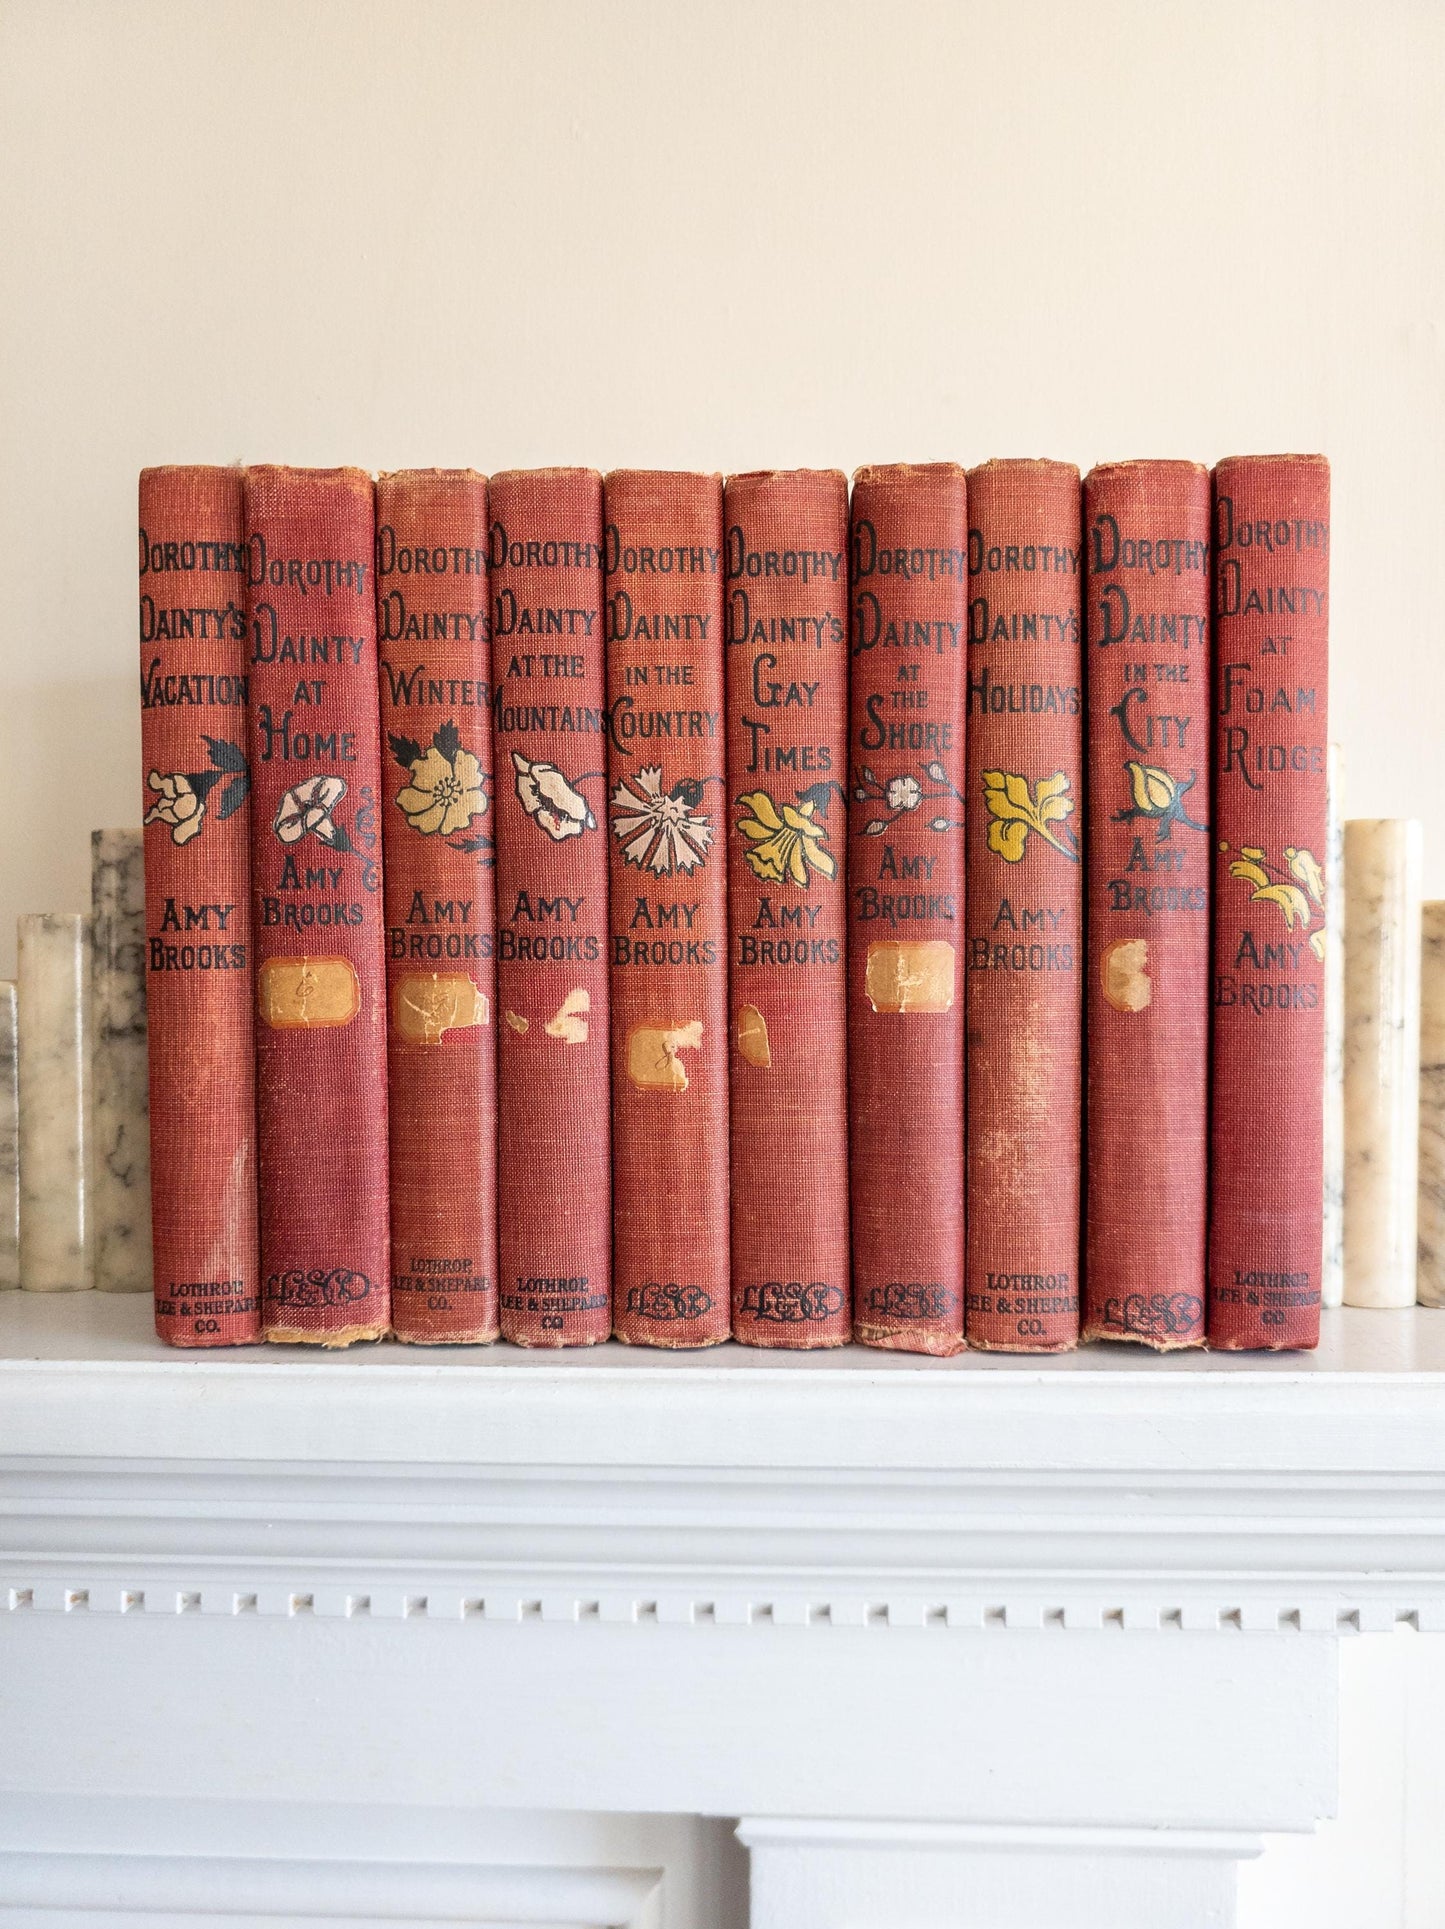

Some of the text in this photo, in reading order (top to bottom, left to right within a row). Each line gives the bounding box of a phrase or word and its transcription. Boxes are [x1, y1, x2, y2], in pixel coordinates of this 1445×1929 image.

[1217, 496, 1328, 554] DOROTHY
[139, 527, 248, 576] DOROTHY
[248, 533, 366, 595] DOROTHY
[489, 522, 604, 569] DOROTHY
[606, 524, 720, 576] DOROTHY
[728, 525, 842, 583] DOROTHY
[853, 519, 967, 586] DOROTHY
[968, 529, 1080, 576] DOROTHY
[1091, 514, 1209, 576] DOROTHY
[1216, 558, 1326, 619] DAINTY
[496, 588, 596, 636] DAINTY
[608, 591, 712, 642] DAINTY
[729, 589, 844, 649] DAINTY'S
[853, 591, 961, 656] DAINTY
[1097, 583, 1207, 649] DAINTY
[250, 603, 364, 664] DAINTY
[1261, 635, 1293, 655] AT
[381, 661, 491, 707] WINTER
[506, 655, 585, 678] AT THE
[625, 666, 694, 685] IN THE
[753, 653, 820, 708] GAY
[897, 664, 920, 682] AT
[1123, 664, 1189, 682] IN THE
[293, 680, 326, 704] AT
[890, 691, 928, 708] THE
[967, 668, 1081, 715] HOLIDAYS
[1219, 662, 1316, 716] FOAM
[259, 705, 357, 761] HOME
[606, 697, 719, 756] COUNTRY
[860, 694, 953, 756] SHORE
[1110, 687, 1190, 753] CITY
[741, 716, 832, 773] TIMES
[1222, 726, 1323, 790] RIDGE
[278, 855, 344, 890] AMY
[878, 845, 938, 880] AMY
[1125, 836, 1186, 872] AMY
[160, 899, 234, 932] AMY
[262, 897, 364, 933] BROOKS
[406, 891, 472, 924] AMY
[510, 890, 584, 922] AMY
[629, 897, 699, 929] AMY
[752, 897, 822, 929] AMY
[856, 886, 957, 928] BROOKS
[992, 899, 1066, 931] AMY
[1107, 879, 1206, 917] BROOKS
[150, 938, 247, 971] BROOKS
[390, 928, 493, 960] BROOKS
[500, 930, 599, 961] BROOKS
[612, 936, 717, 966] BROOKS
[738, 936, 840, 966] BROOKS
[970, 938, 1073, 971] BROOKS
[1234, 931, 1304, 970] AMY
[1215, 976, 1318, 1016] BROOKS
[415, 1278, 426, 1292] &
[528, 1297, 539, 1311] &
[180, 1303, 191, 1315] &
[996, 1298, 1011, 1314] &
